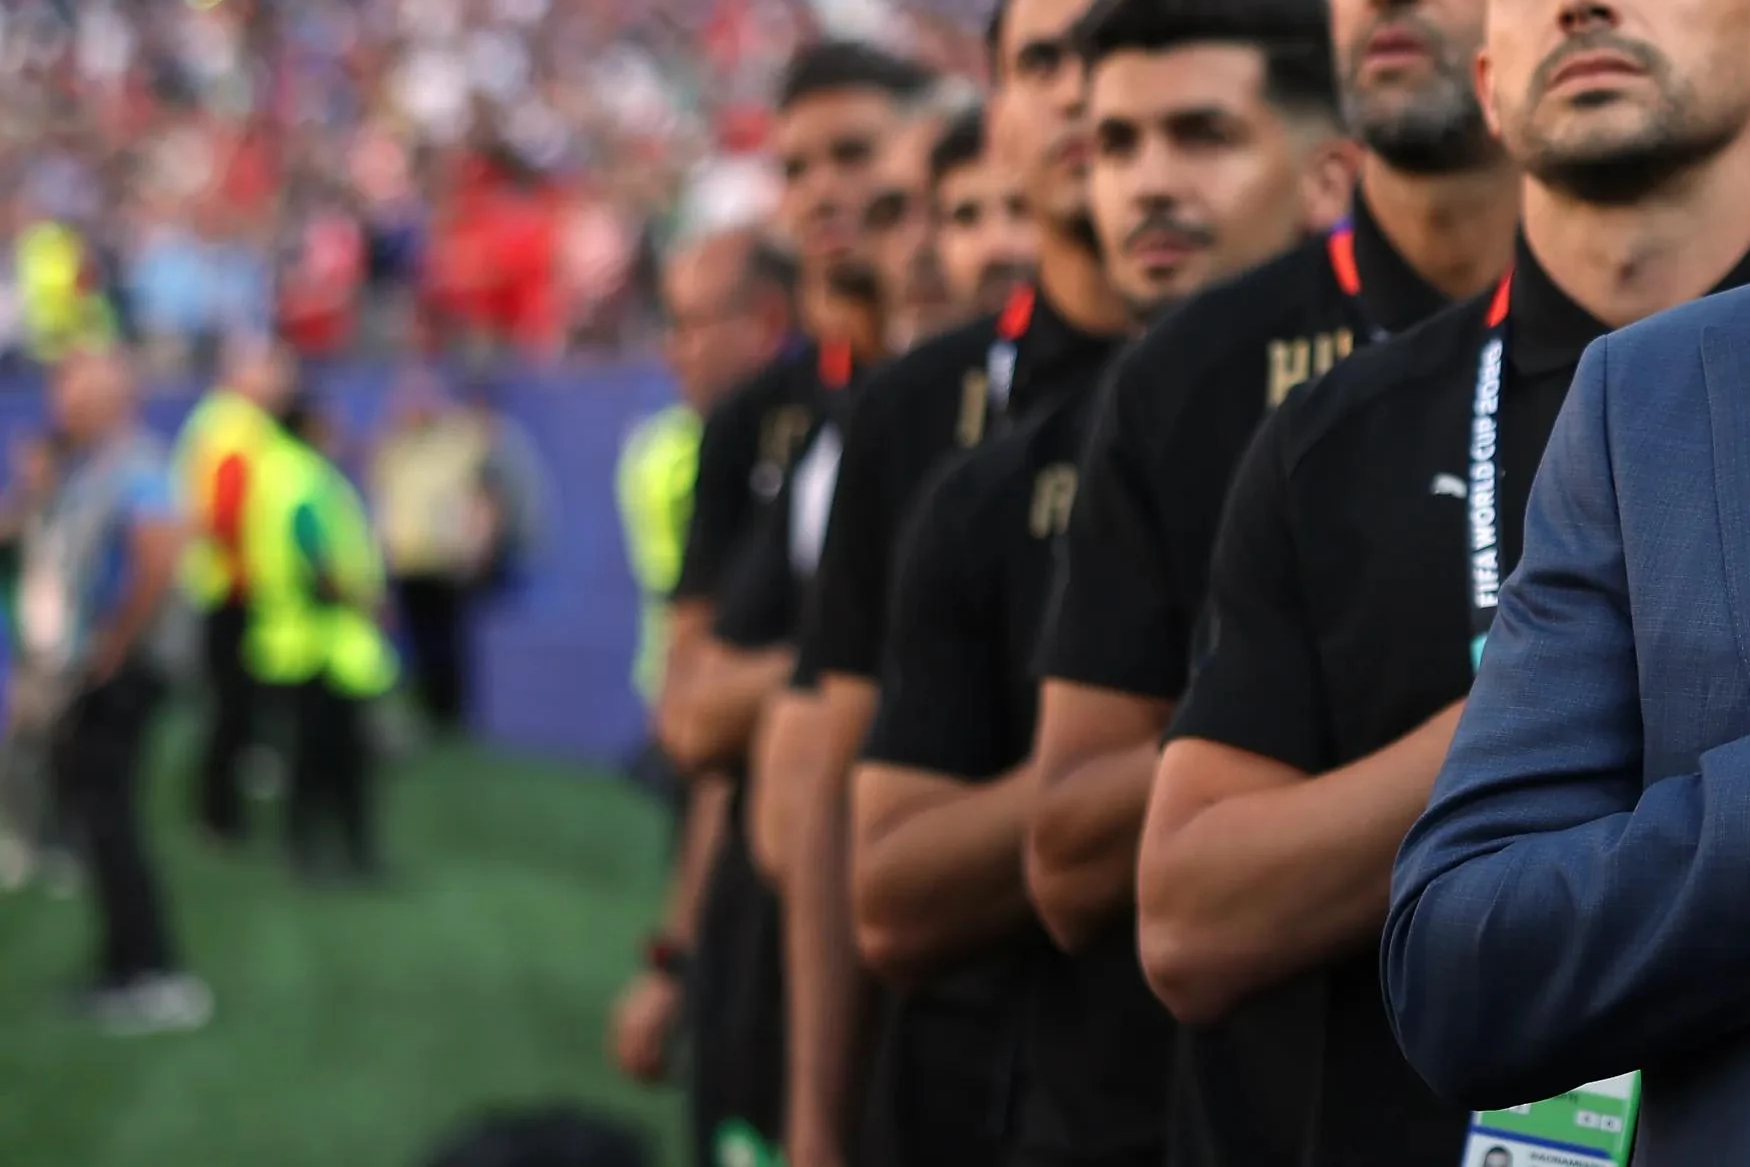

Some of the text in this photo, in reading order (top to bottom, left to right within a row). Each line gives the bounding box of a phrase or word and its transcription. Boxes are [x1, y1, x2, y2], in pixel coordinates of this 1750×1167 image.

[1470, 417, 1498, 460] CUP
[1469, 461, 1496, 548] WORLD
[1473, 549, 1498, 608] FIFA
